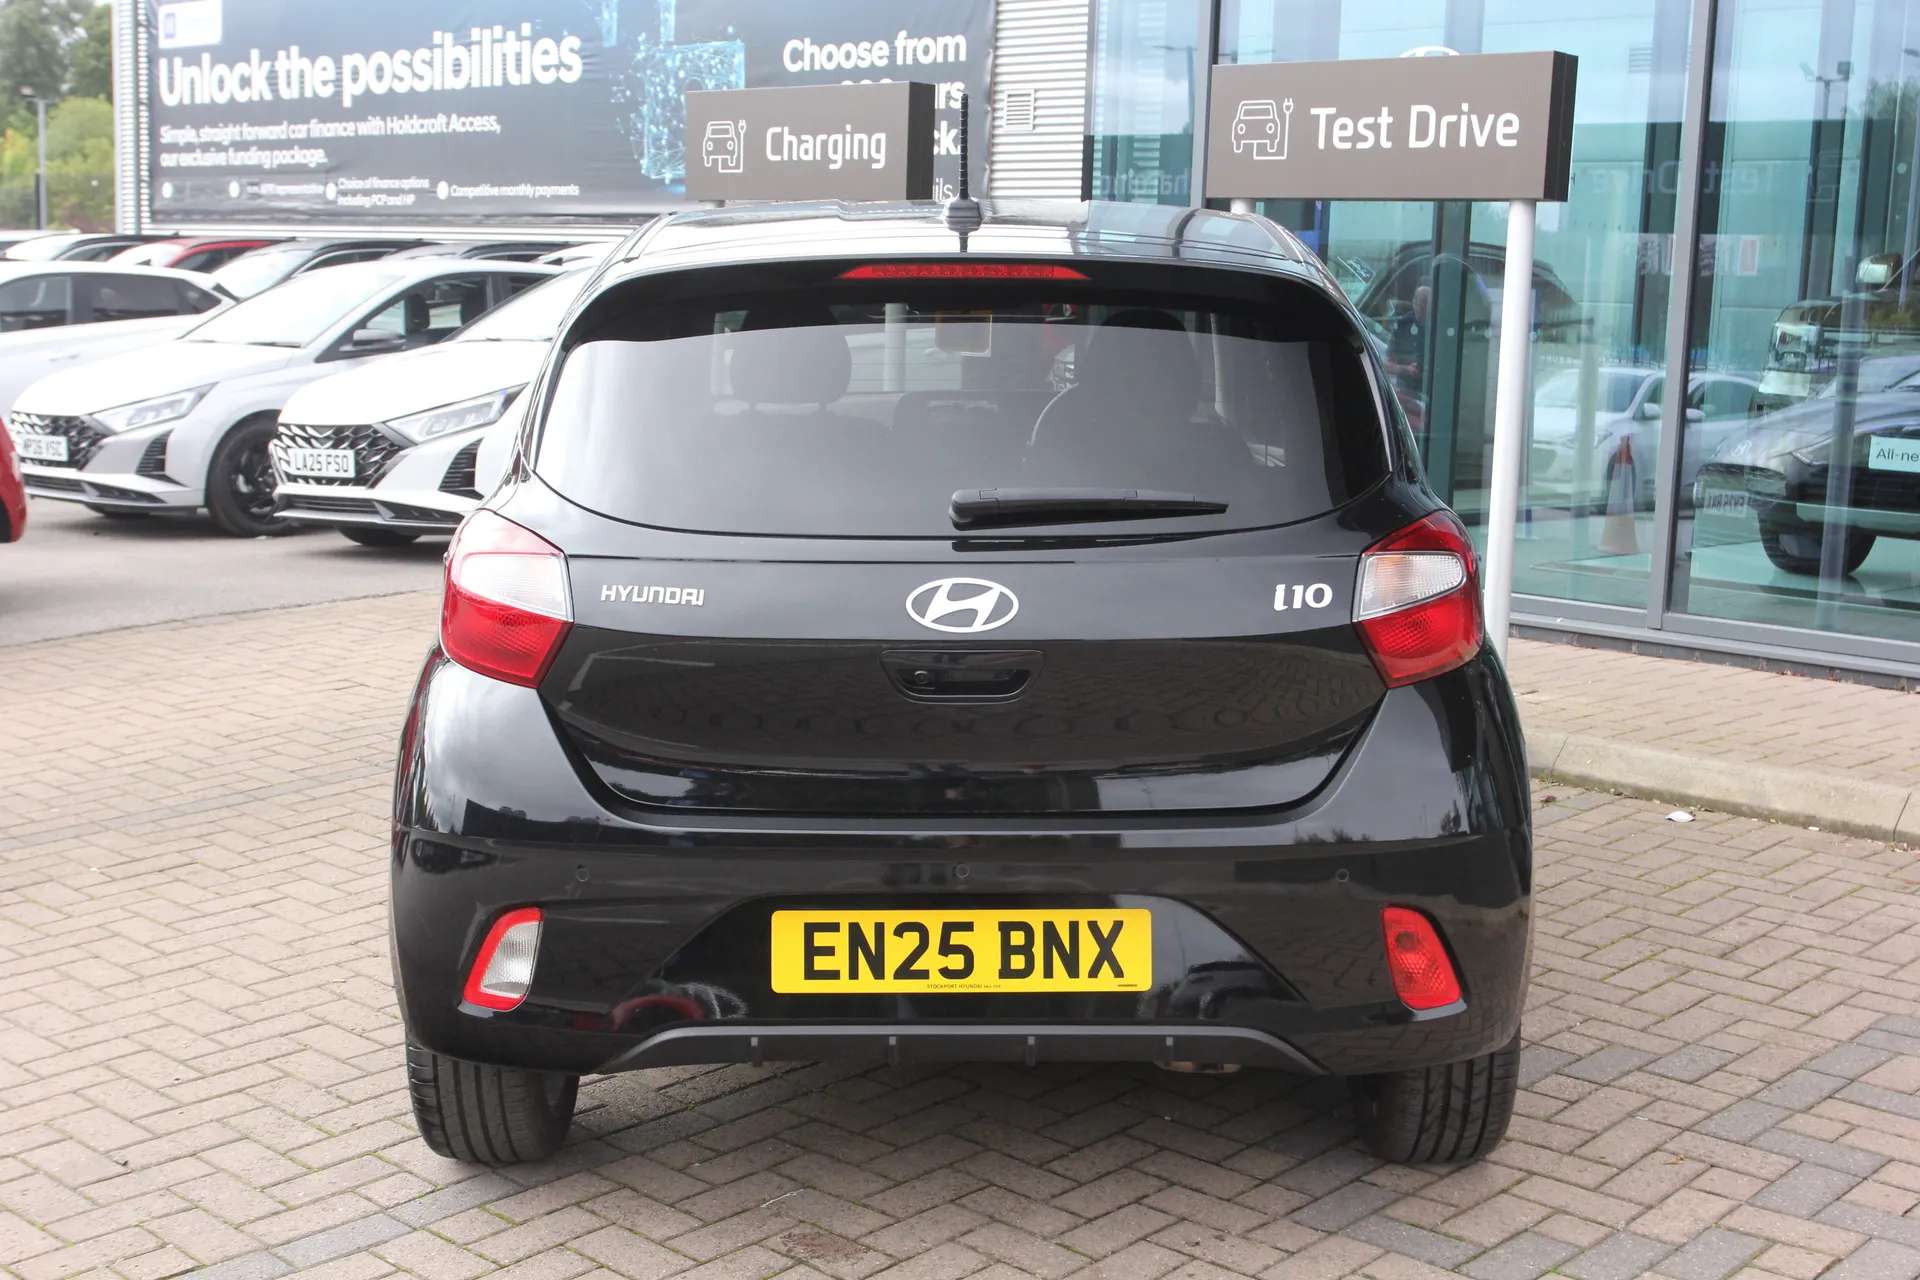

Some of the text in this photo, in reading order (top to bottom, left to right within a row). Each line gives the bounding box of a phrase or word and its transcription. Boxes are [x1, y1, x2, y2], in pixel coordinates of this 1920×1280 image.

[158, 22, 583, 107] Unlock the possibilities
[783, 30, 966, 73] Choose from
[934, 81, 965, 109] rs
[160, 113, 501, 146] Simple, straight forward car finance with Holdcroft Access,
[1310, 103, 1519, 150] Test Drive
[160, 145, 328, 169] our exclusive funding package.
[766, 124, 887, 169] Charging
[450, 184, 580, 198] Competitive monthly payments
[294, 453, 323, 472] LA25
[600, 584, 705, 606] HYUNDAI
[1273, 583, 1333, 611] i10
[803, 919, 1124, 981] EN25 BNX
